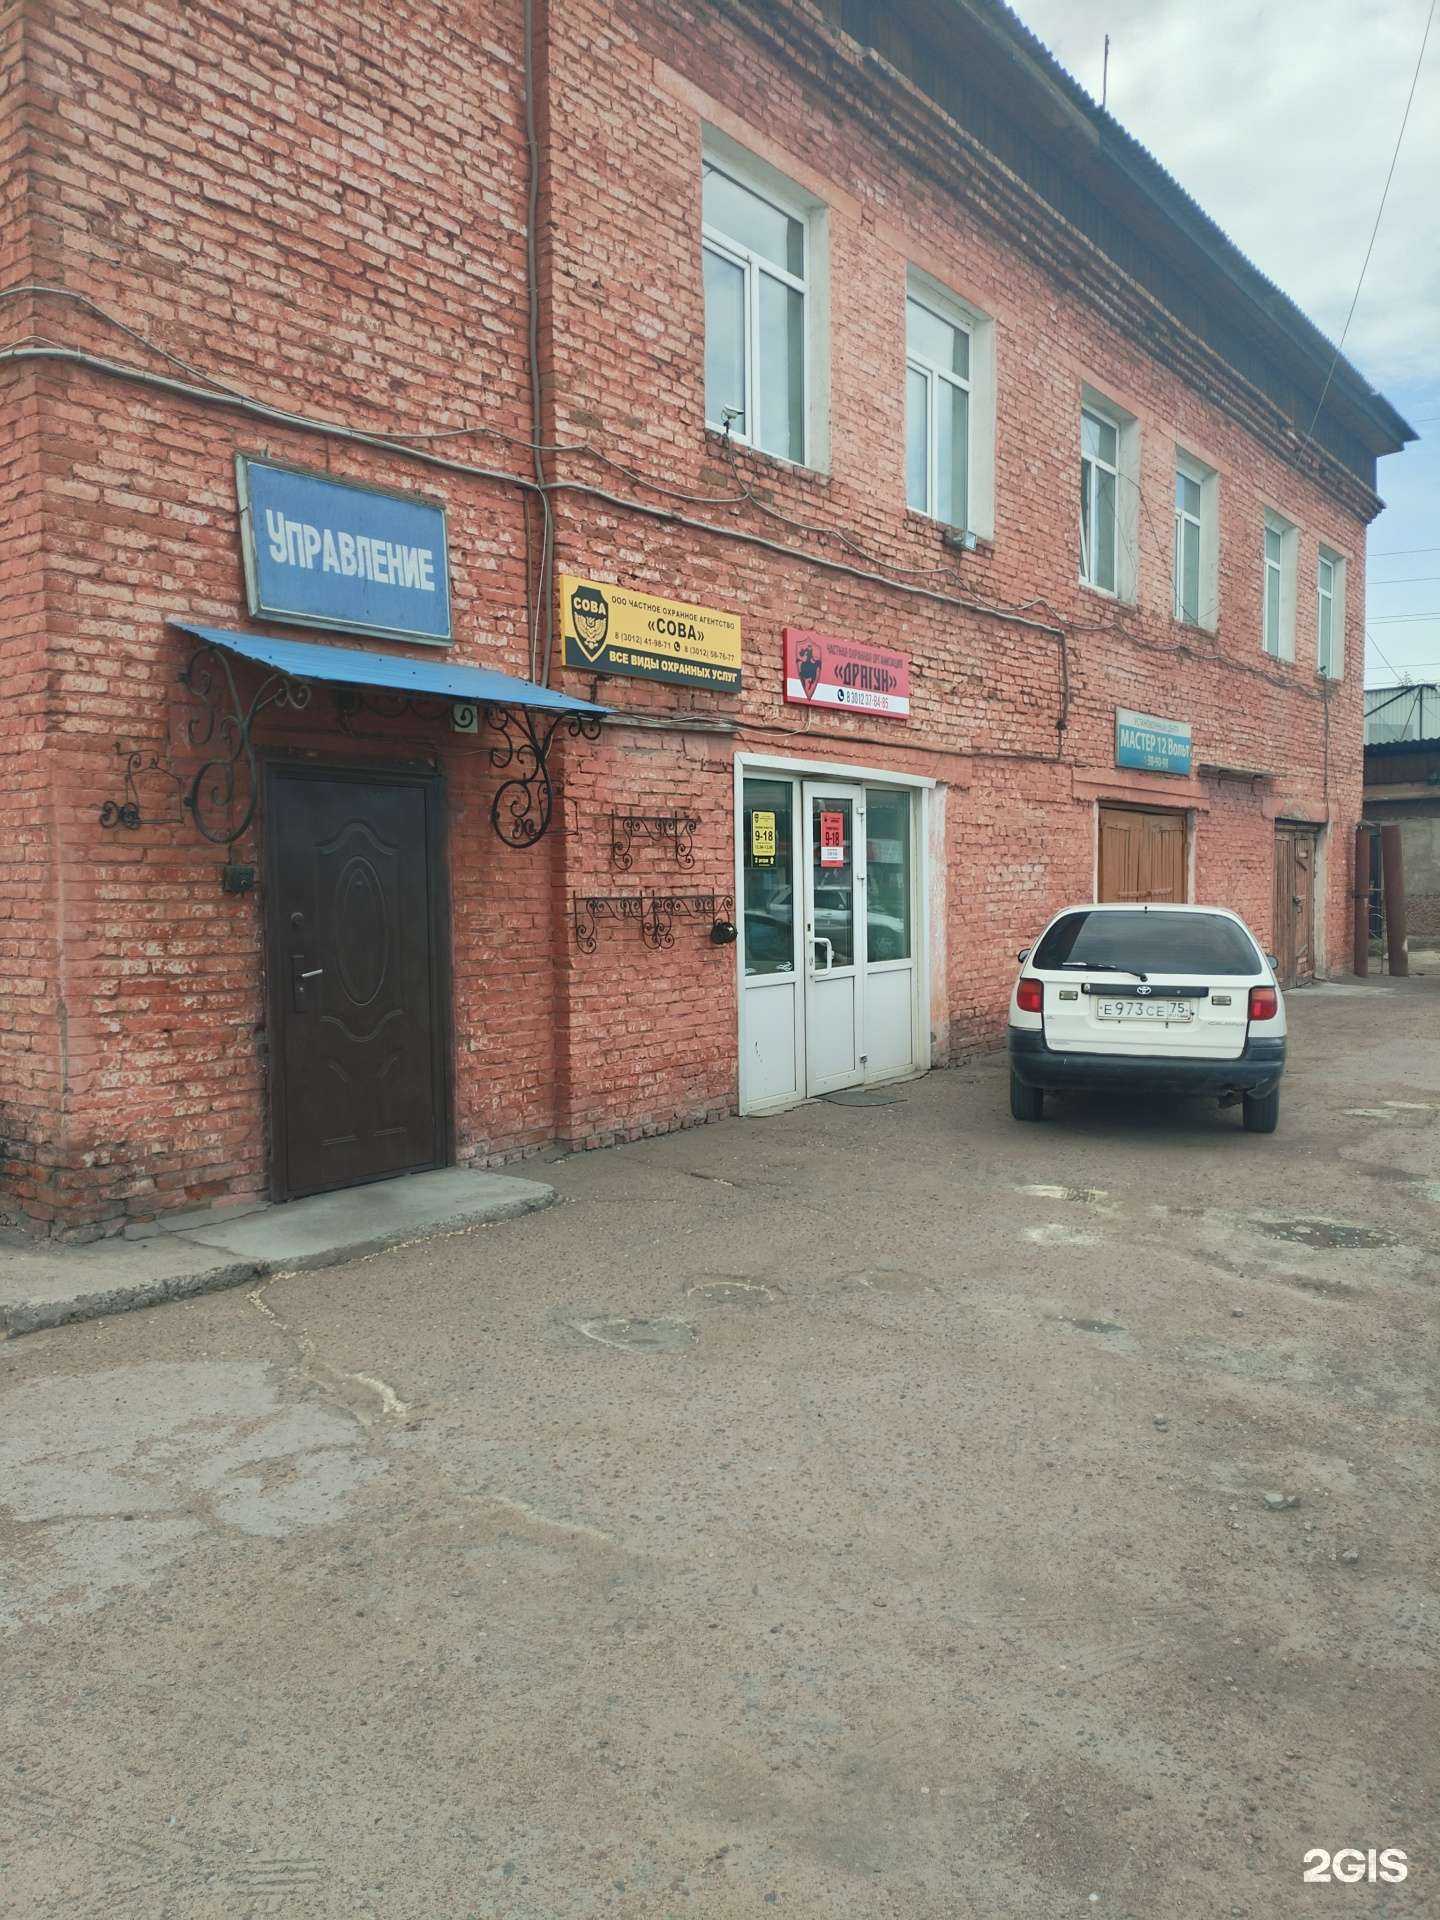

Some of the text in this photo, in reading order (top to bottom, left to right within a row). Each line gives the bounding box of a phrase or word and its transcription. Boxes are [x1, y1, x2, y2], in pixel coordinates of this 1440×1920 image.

[265, 508, 435, 592] УПРАВЛЕНИЕ
[573, 597, 606, 615] СОВА
[611, 596, 735, 630] ООО ЧАСТНОЕ ОХРАННОЕ АГЕНТСТВО
[620, 633, 643, 645] (3012)
[647, 618, 704, 641] «СОВА»
[609, 651, 737, 683] ВСЕ ВИДЫ ОХРАННЫХ УСЛУГ
[834, 662, 897, 692] «ДРАГУН»
[1120, 728, 1190, 758] МАСТЕР 12 Вольт
[755, 830, 773, 841] 9-18
[825, 831, 840, 846] 9-18
[1170, 1002, 1185, 1013] 75
